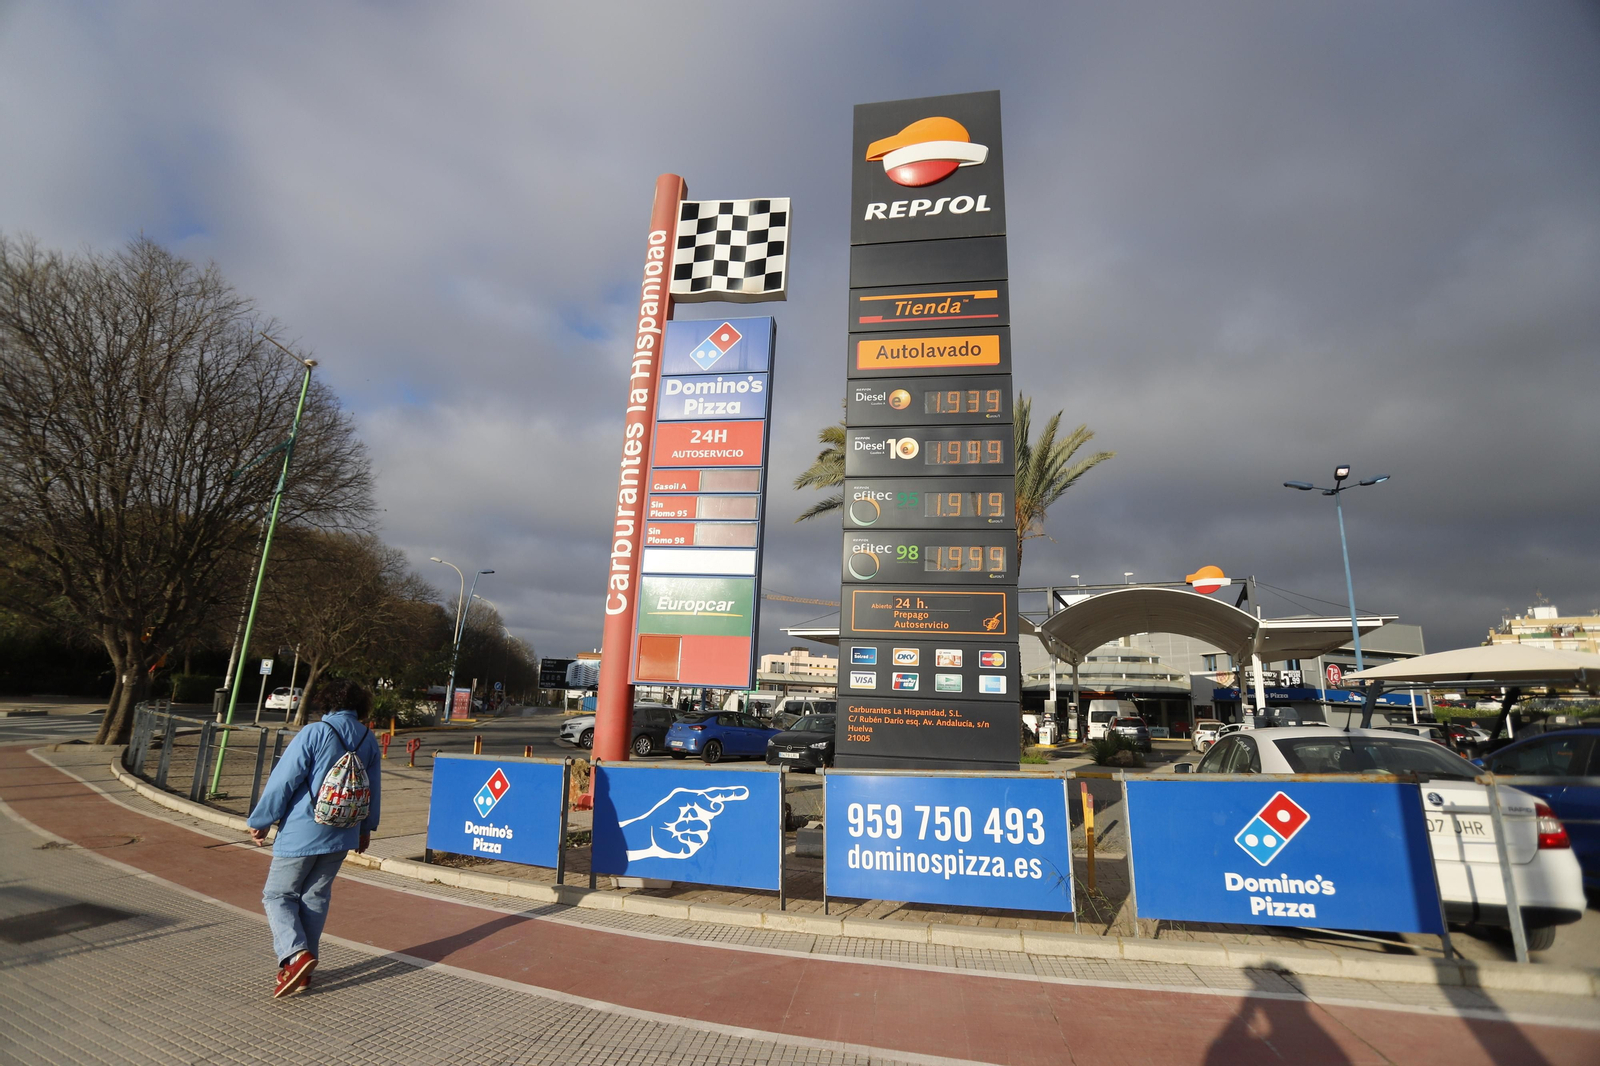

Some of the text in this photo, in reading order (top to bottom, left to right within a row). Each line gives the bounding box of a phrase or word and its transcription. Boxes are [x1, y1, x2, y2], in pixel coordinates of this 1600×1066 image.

[864, 194, 991, 221] REPSOL
[875, 341, 982, 360] Autolavado
[665, 375, 763, 395] Domino's
[855, 391, 886, 402] Diesel
[936, 390, 1000, 413] 1.939
[683, 397, 741, 415] Pizza
[605, 230, 667, 615] Carburantes la Hispanidad
[689, 429, 728, 444] 24H
[671, 449, 744, 458] AUTOSERVICIO
[854, 437, 919, 460] Diesel 10
[936, 440, 1001, 464] 1.999
[853, 490, 919, 507] efitec 95
[936, 492, 1002, 517] 1.919
[648, 527, 661, 535] Sin
[852, 543, 919, 560] efitec 98
[936, 546, 1004, 571] 1.999
[656, 596, 735, 615] Europcar
[895, 597, 910, 609] 24
[916, 597, 929, 609] h.
[893, 610, 929, 620] Prepago
[893, 620, 950, 629] Autoservicio
[854, 676, 873, 684] VISA
[848, 706, 892, 715] Carburantes
[903, 708, 947, 718] Hispanidad,
[847, 725, 873, 733] Huelva
[884, 717, 904, 725] Darío
[905, 719, 921, 727] esq.
[936, 719, 975, 728] Andalucía,
[977, 720, 990, 728] s/n
[464, 820, 513, 840] Domino's
[847, 802, 1046, 845] 959 750 493
[1454, 820, 1486, 835] JHR
[472, 836, 502, 854] Pizza
[847, 843, 1043, 880] dominospizza.es
[1224, 872, 1336, 895] Domino's
[1250, 896, 1317, 919] Pizza
